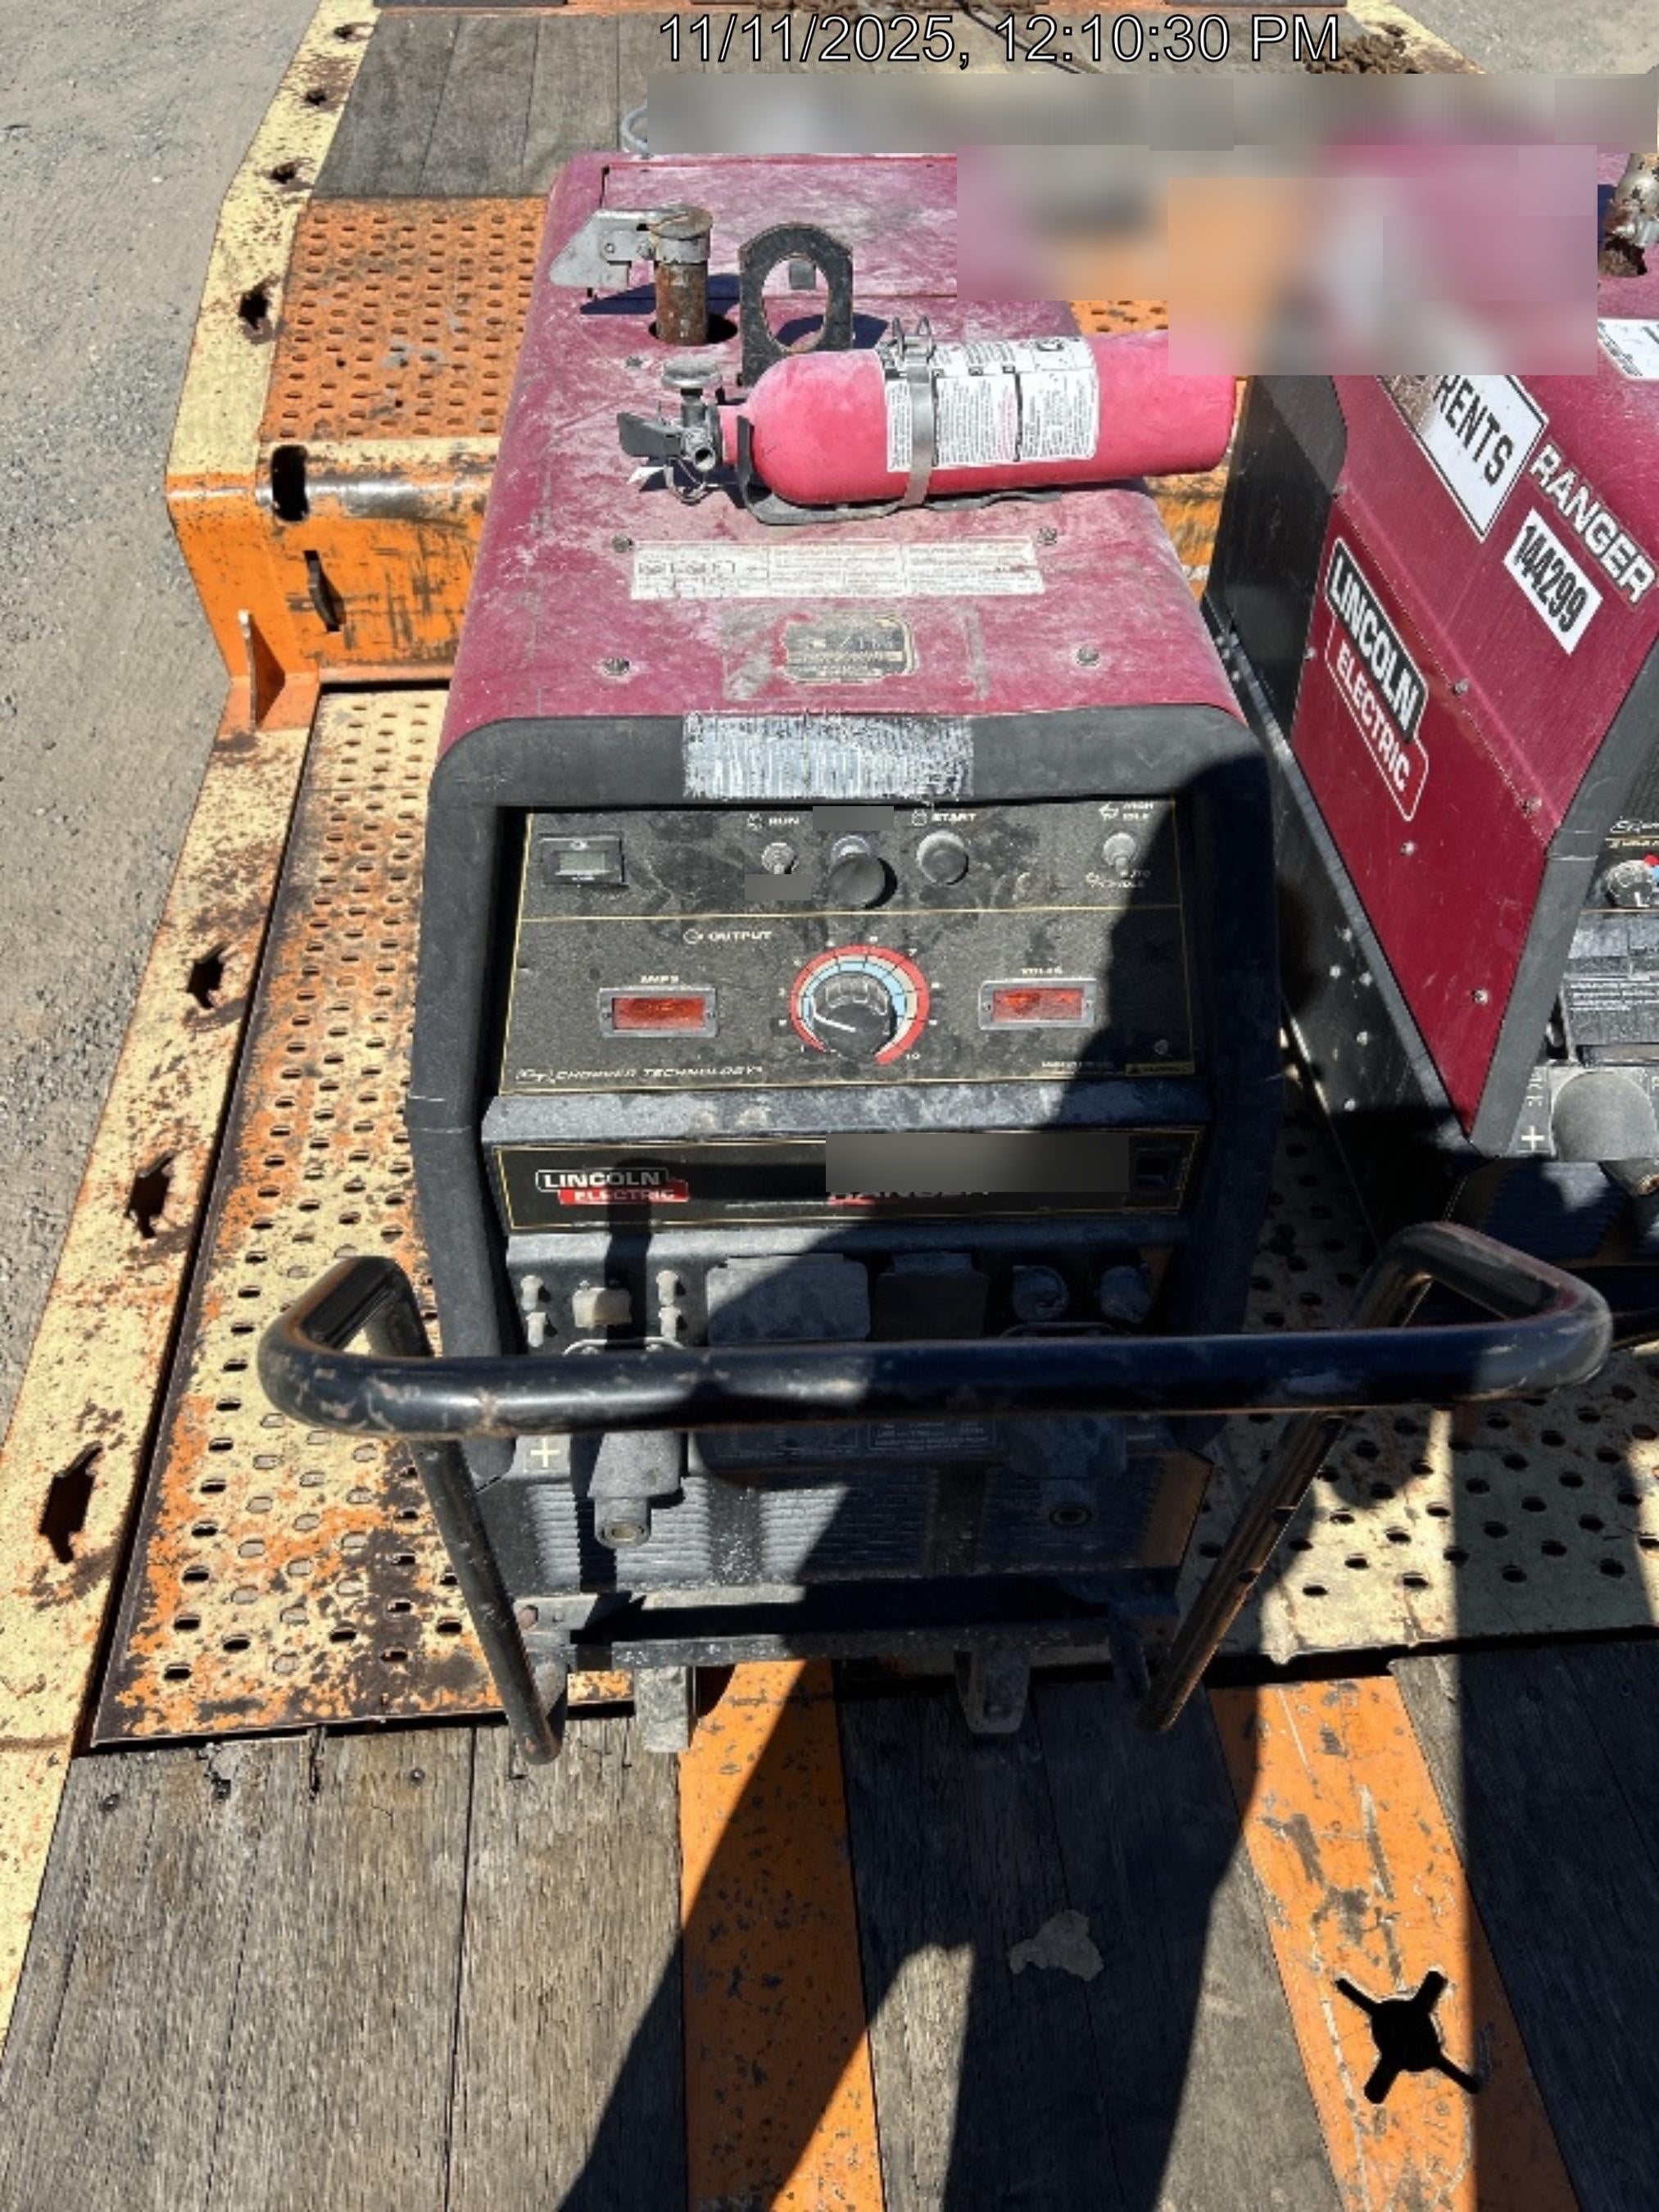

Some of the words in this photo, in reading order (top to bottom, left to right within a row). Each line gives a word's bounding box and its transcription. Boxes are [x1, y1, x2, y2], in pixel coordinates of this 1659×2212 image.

[1529, 443, 1657, 604] RANGER
[1513, 525, 1588, 632] 144299
[1330, 554, 1420, 732] LINCOLN
[1336, 638, 1410, 792] ELECTRIC
[707, 931, 773, 942] OUTPUT
[544, 1172, 660, 1188] LINCOLN
[574, 1190, 676, 1201] ELECTRIC
